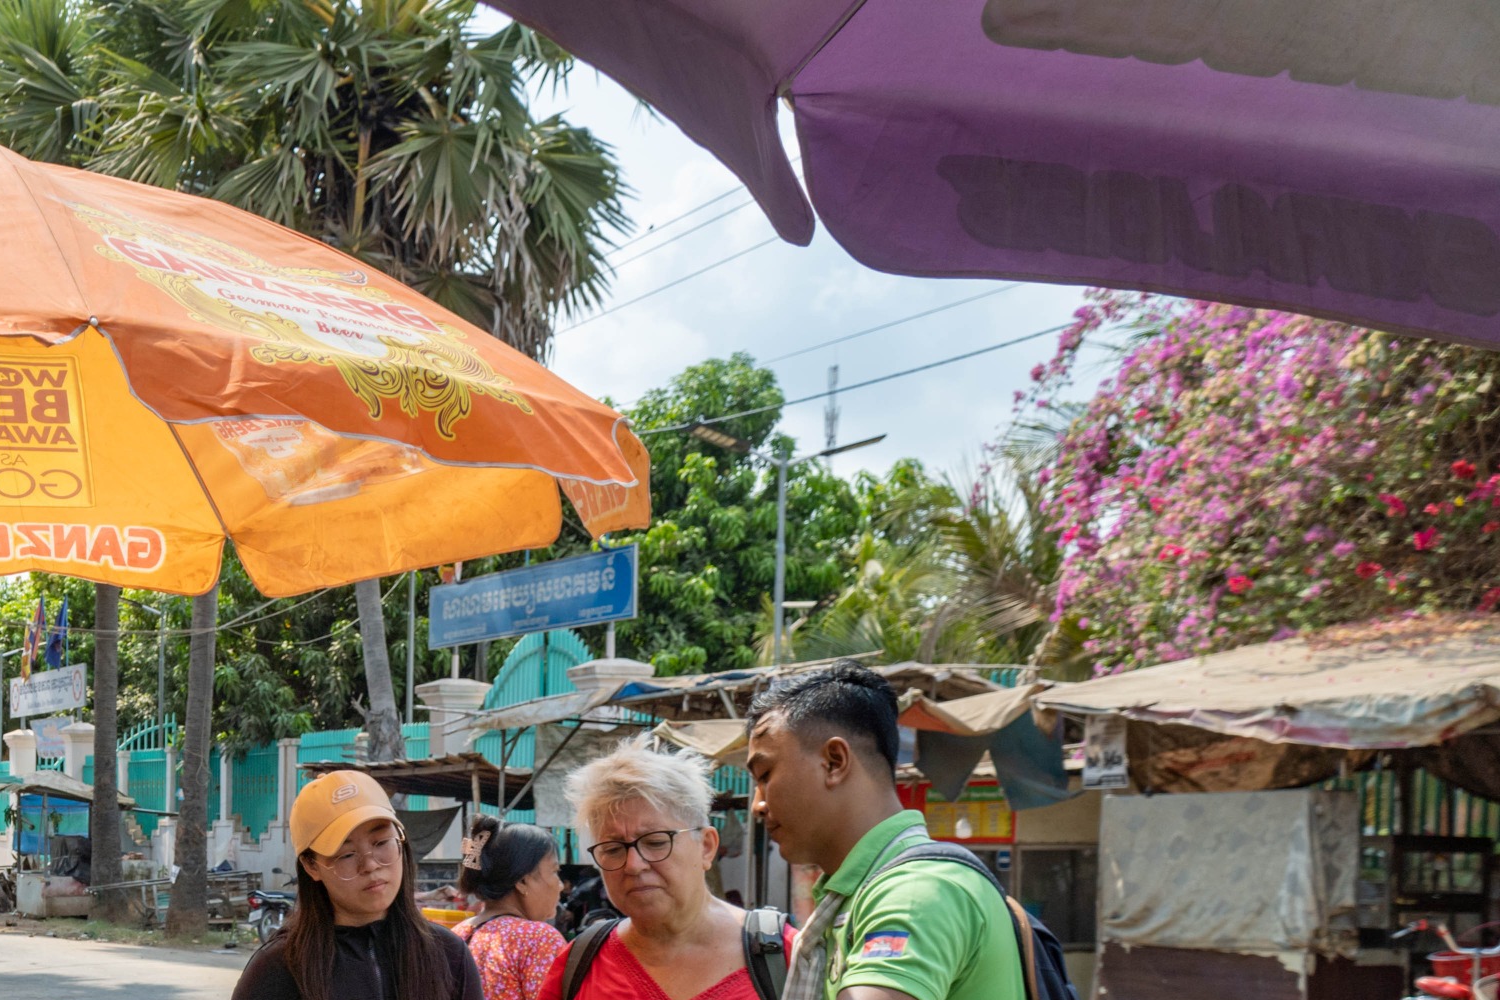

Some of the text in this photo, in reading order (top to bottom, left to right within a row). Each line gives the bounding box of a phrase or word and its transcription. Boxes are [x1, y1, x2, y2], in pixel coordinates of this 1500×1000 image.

[107, 236, 442, 333] GANZBERG
[217, 288, 413, 337] German Premium
[317, 319, 364, 340] Beer
